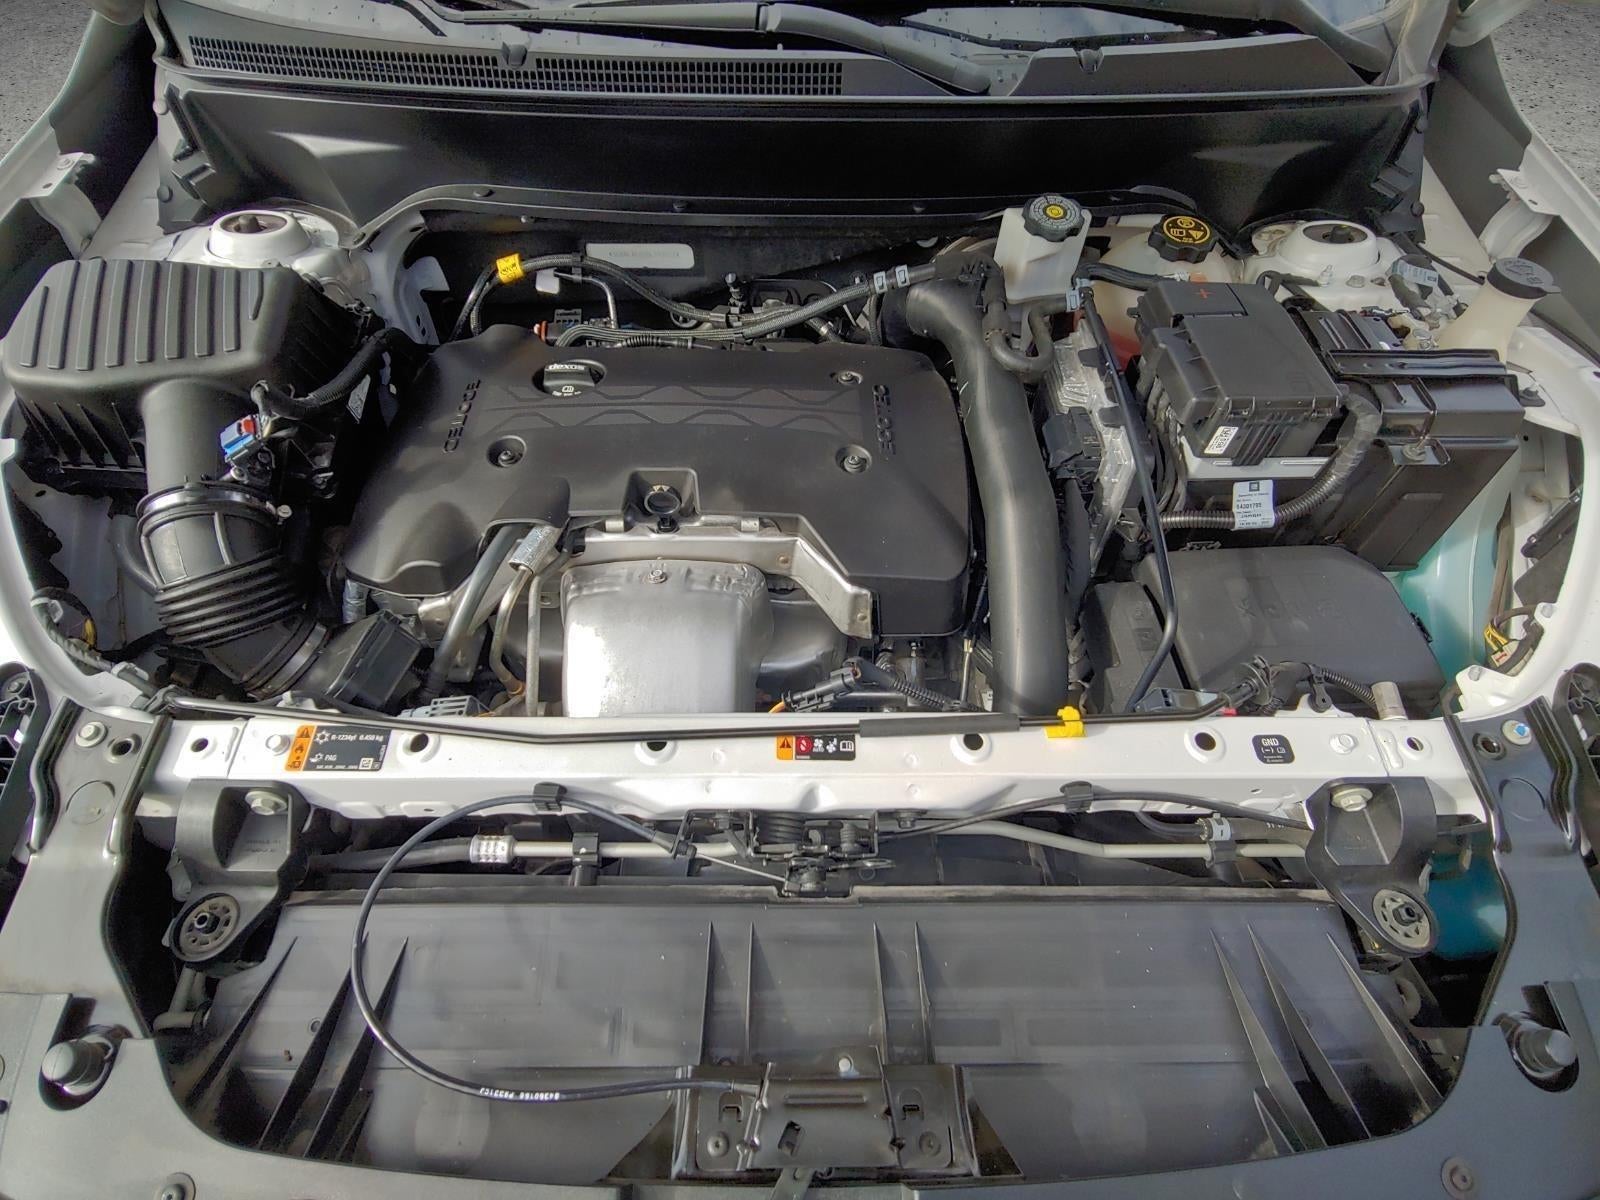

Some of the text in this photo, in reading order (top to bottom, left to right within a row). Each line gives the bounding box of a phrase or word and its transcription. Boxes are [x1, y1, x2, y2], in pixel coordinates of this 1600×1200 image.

[549, 363, 585, 371] dexos
[1261, 737, 1279, 747] GND
[324, 753, 337, 761] PAG
